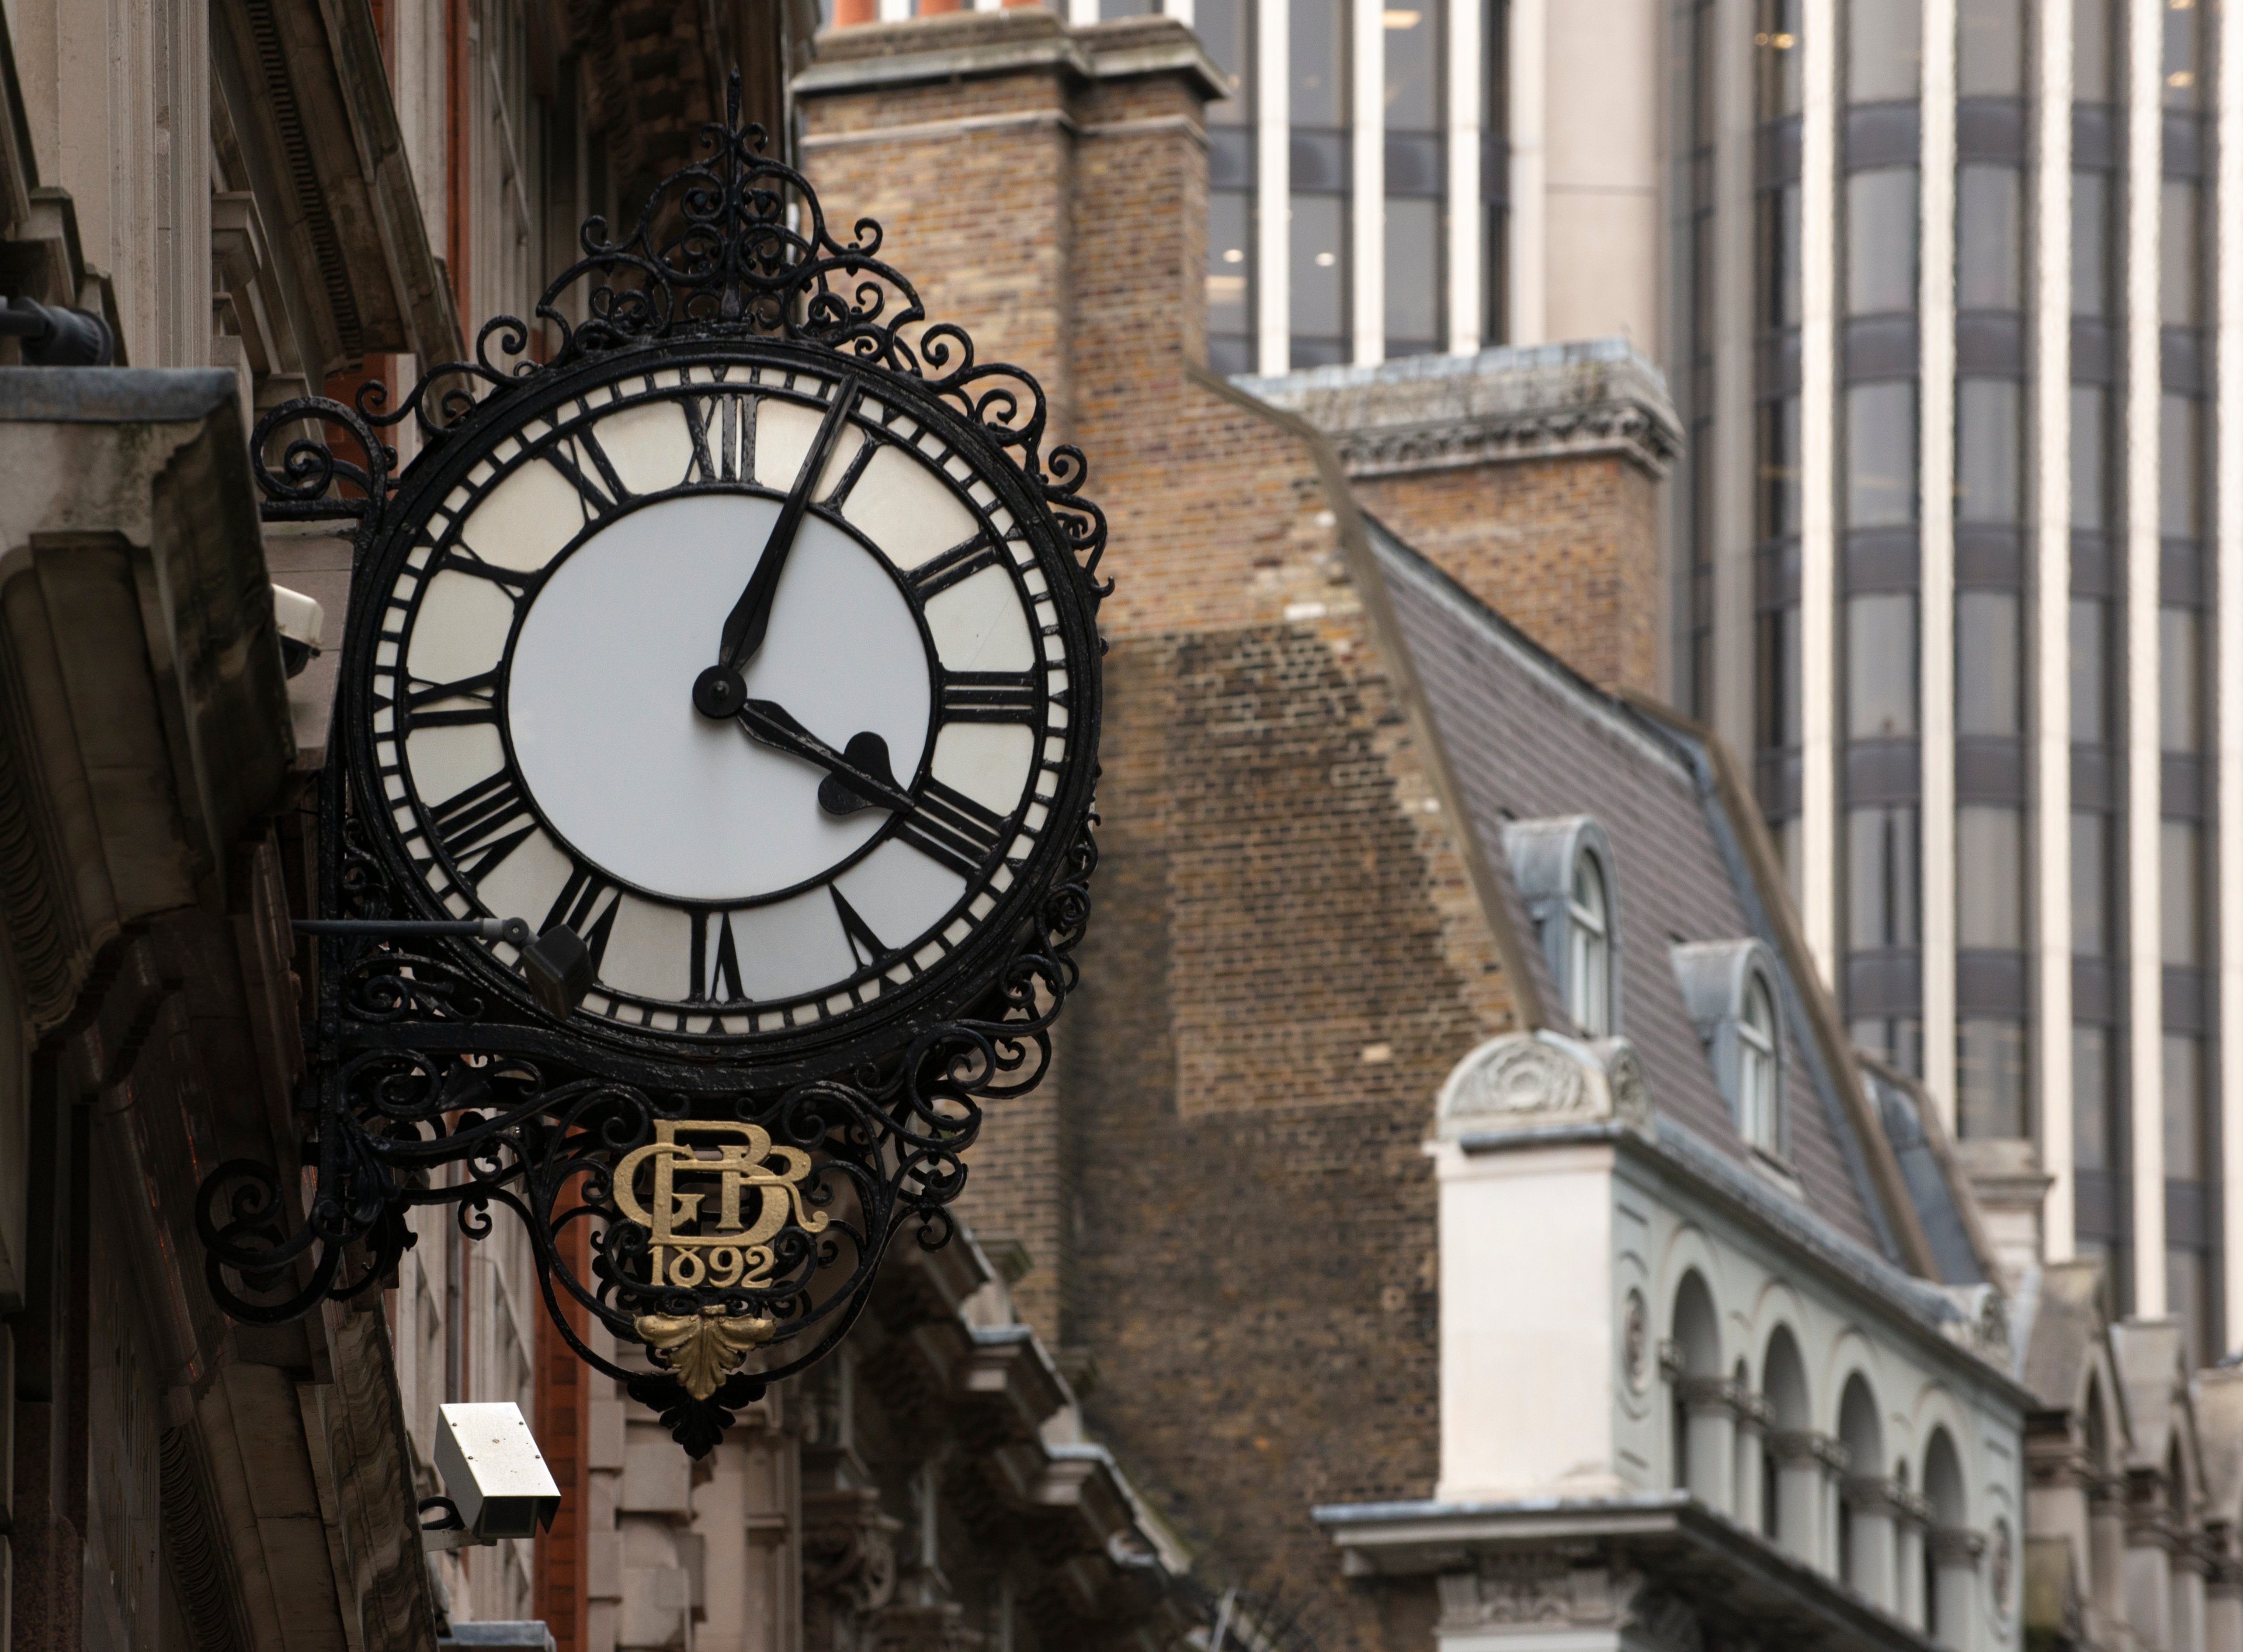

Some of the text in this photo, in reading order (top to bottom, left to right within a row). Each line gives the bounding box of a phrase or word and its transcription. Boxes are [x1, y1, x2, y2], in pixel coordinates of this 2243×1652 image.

[533, 425, 643, 523] XI
[673, 393, 766, 485] XII
[822, 429, 890, 518] I
[435, 529, 540, 612] X
[902, 530, 1005, 609] II
[407, 661, 500, 737] IX
[938, 671, 1037, 724] III
[423, 764, 542, 889] VIII
[897, 776, 1015, 883] IIII
[682, 909, 754, 1002] VI
[828, 881, 902, 978] V
[648, 1245, 776, 1289] 1892
